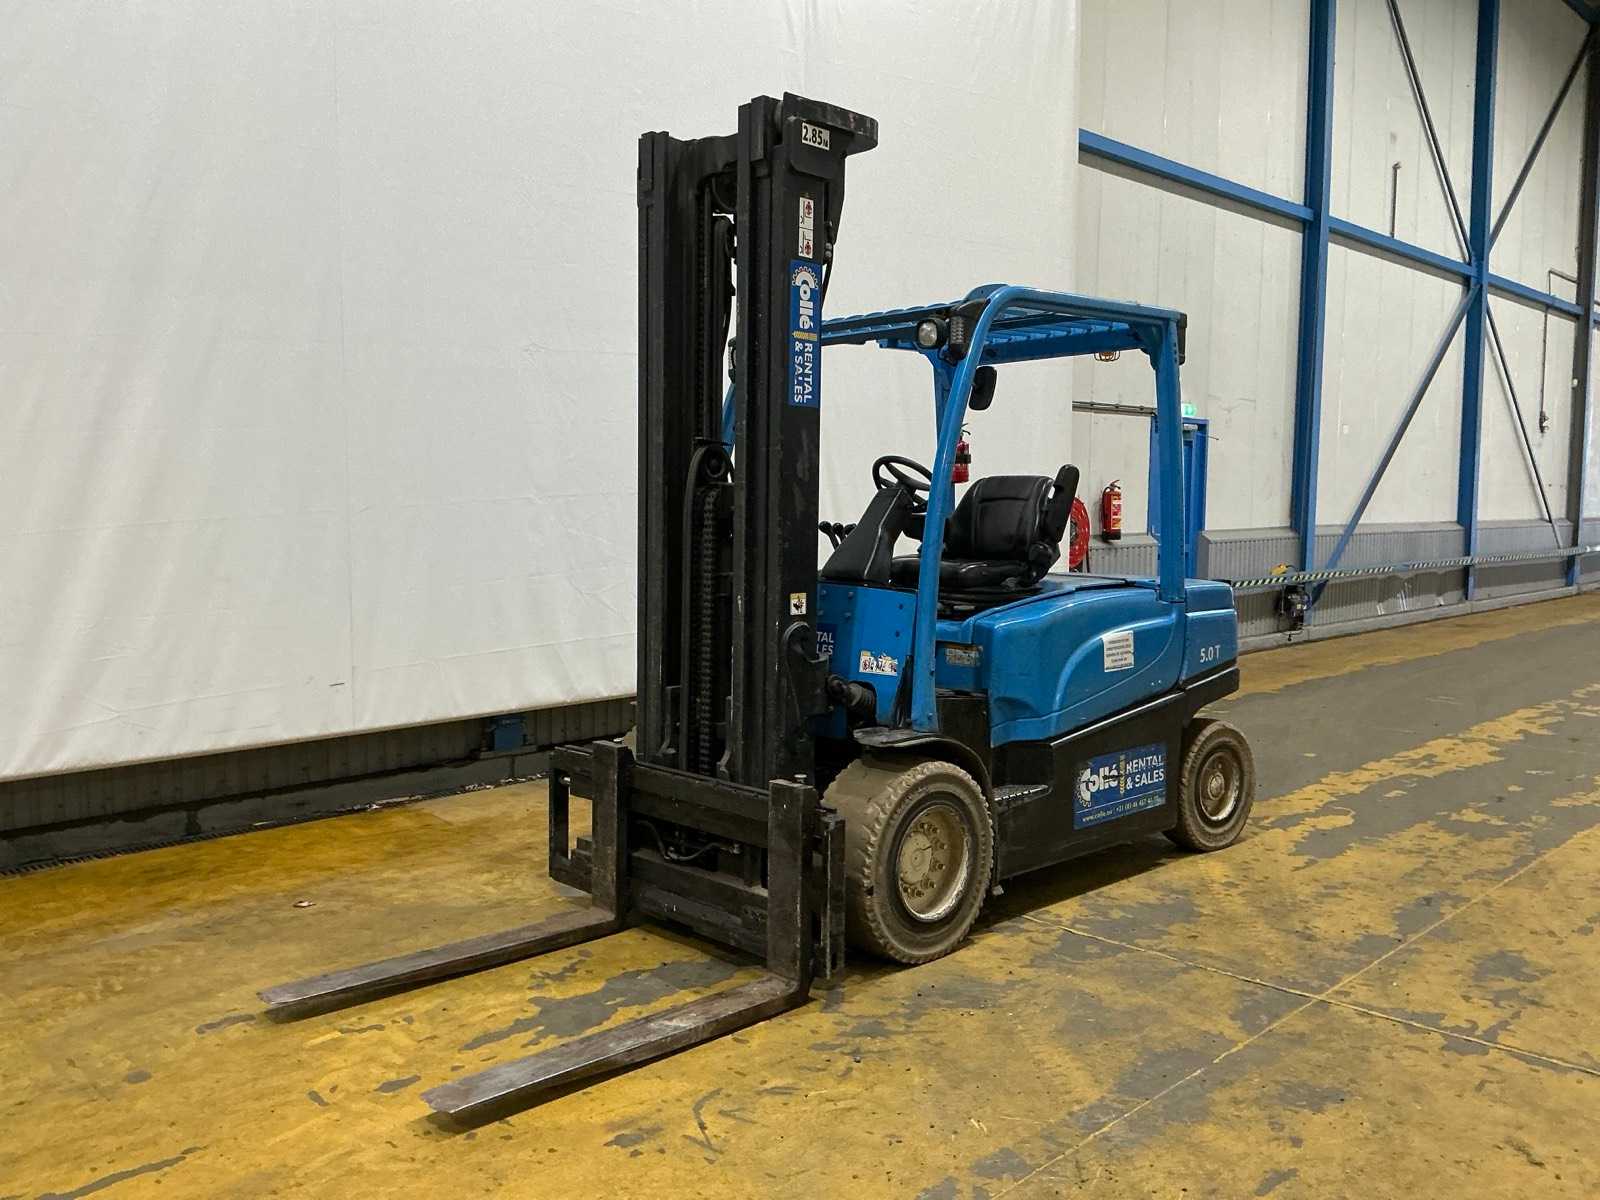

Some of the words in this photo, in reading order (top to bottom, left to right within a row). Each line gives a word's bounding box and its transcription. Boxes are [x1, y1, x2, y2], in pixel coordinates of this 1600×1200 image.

[795, 341, 804, 352] &
[794, 355, 803, 403] SALES
[803, 342, 813, 403] RENTAL
[1126, 755, 1164, 774] RENTAL
[1126, 777, 1133, 790] &
[1135, 769, 1164, 788] SALES
